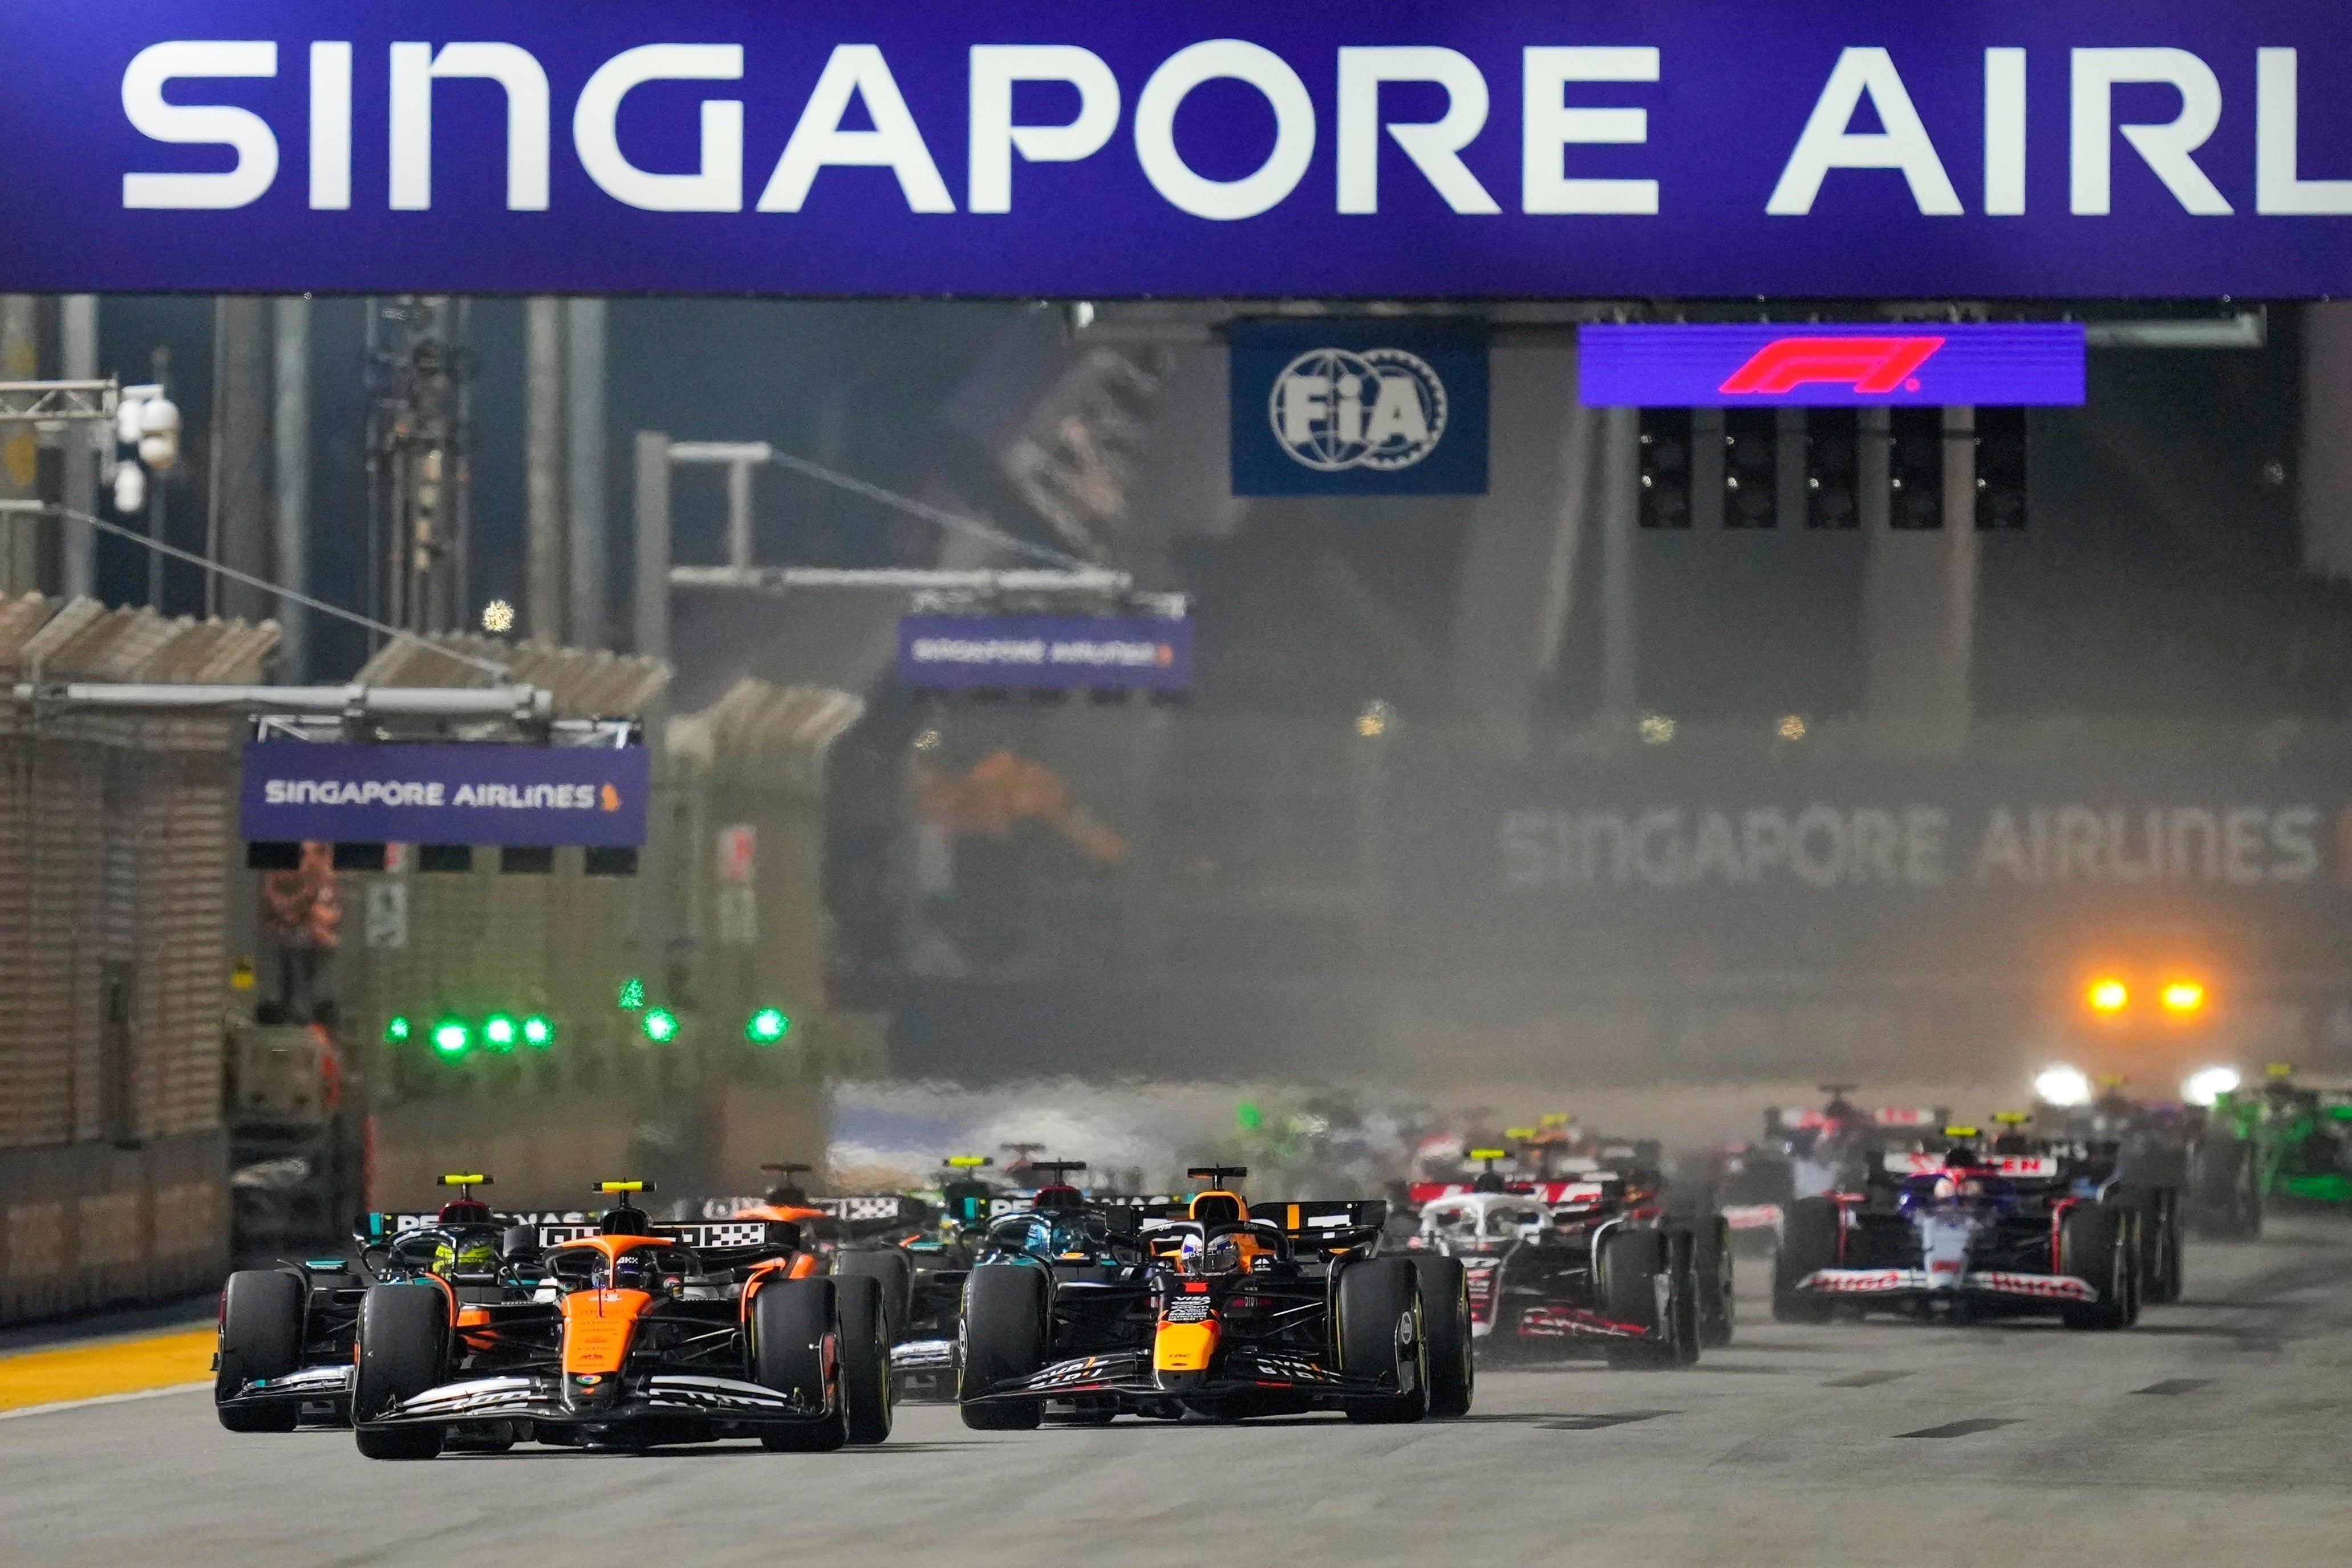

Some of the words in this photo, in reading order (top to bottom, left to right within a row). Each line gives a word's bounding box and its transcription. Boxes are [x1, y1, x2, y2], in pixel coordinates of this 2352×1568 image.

[121, 39, 1660, 220] SINGAPORE
[1766, 47, 2352, 216] AIRL
[265, 780, 444, 806] SINGAPORE
[453, 783, 595, 809] AIRLINES
[1500, 807, 1947, 885] SINGAPORE
[1976, 807, 2319, 885] AIRLINES
